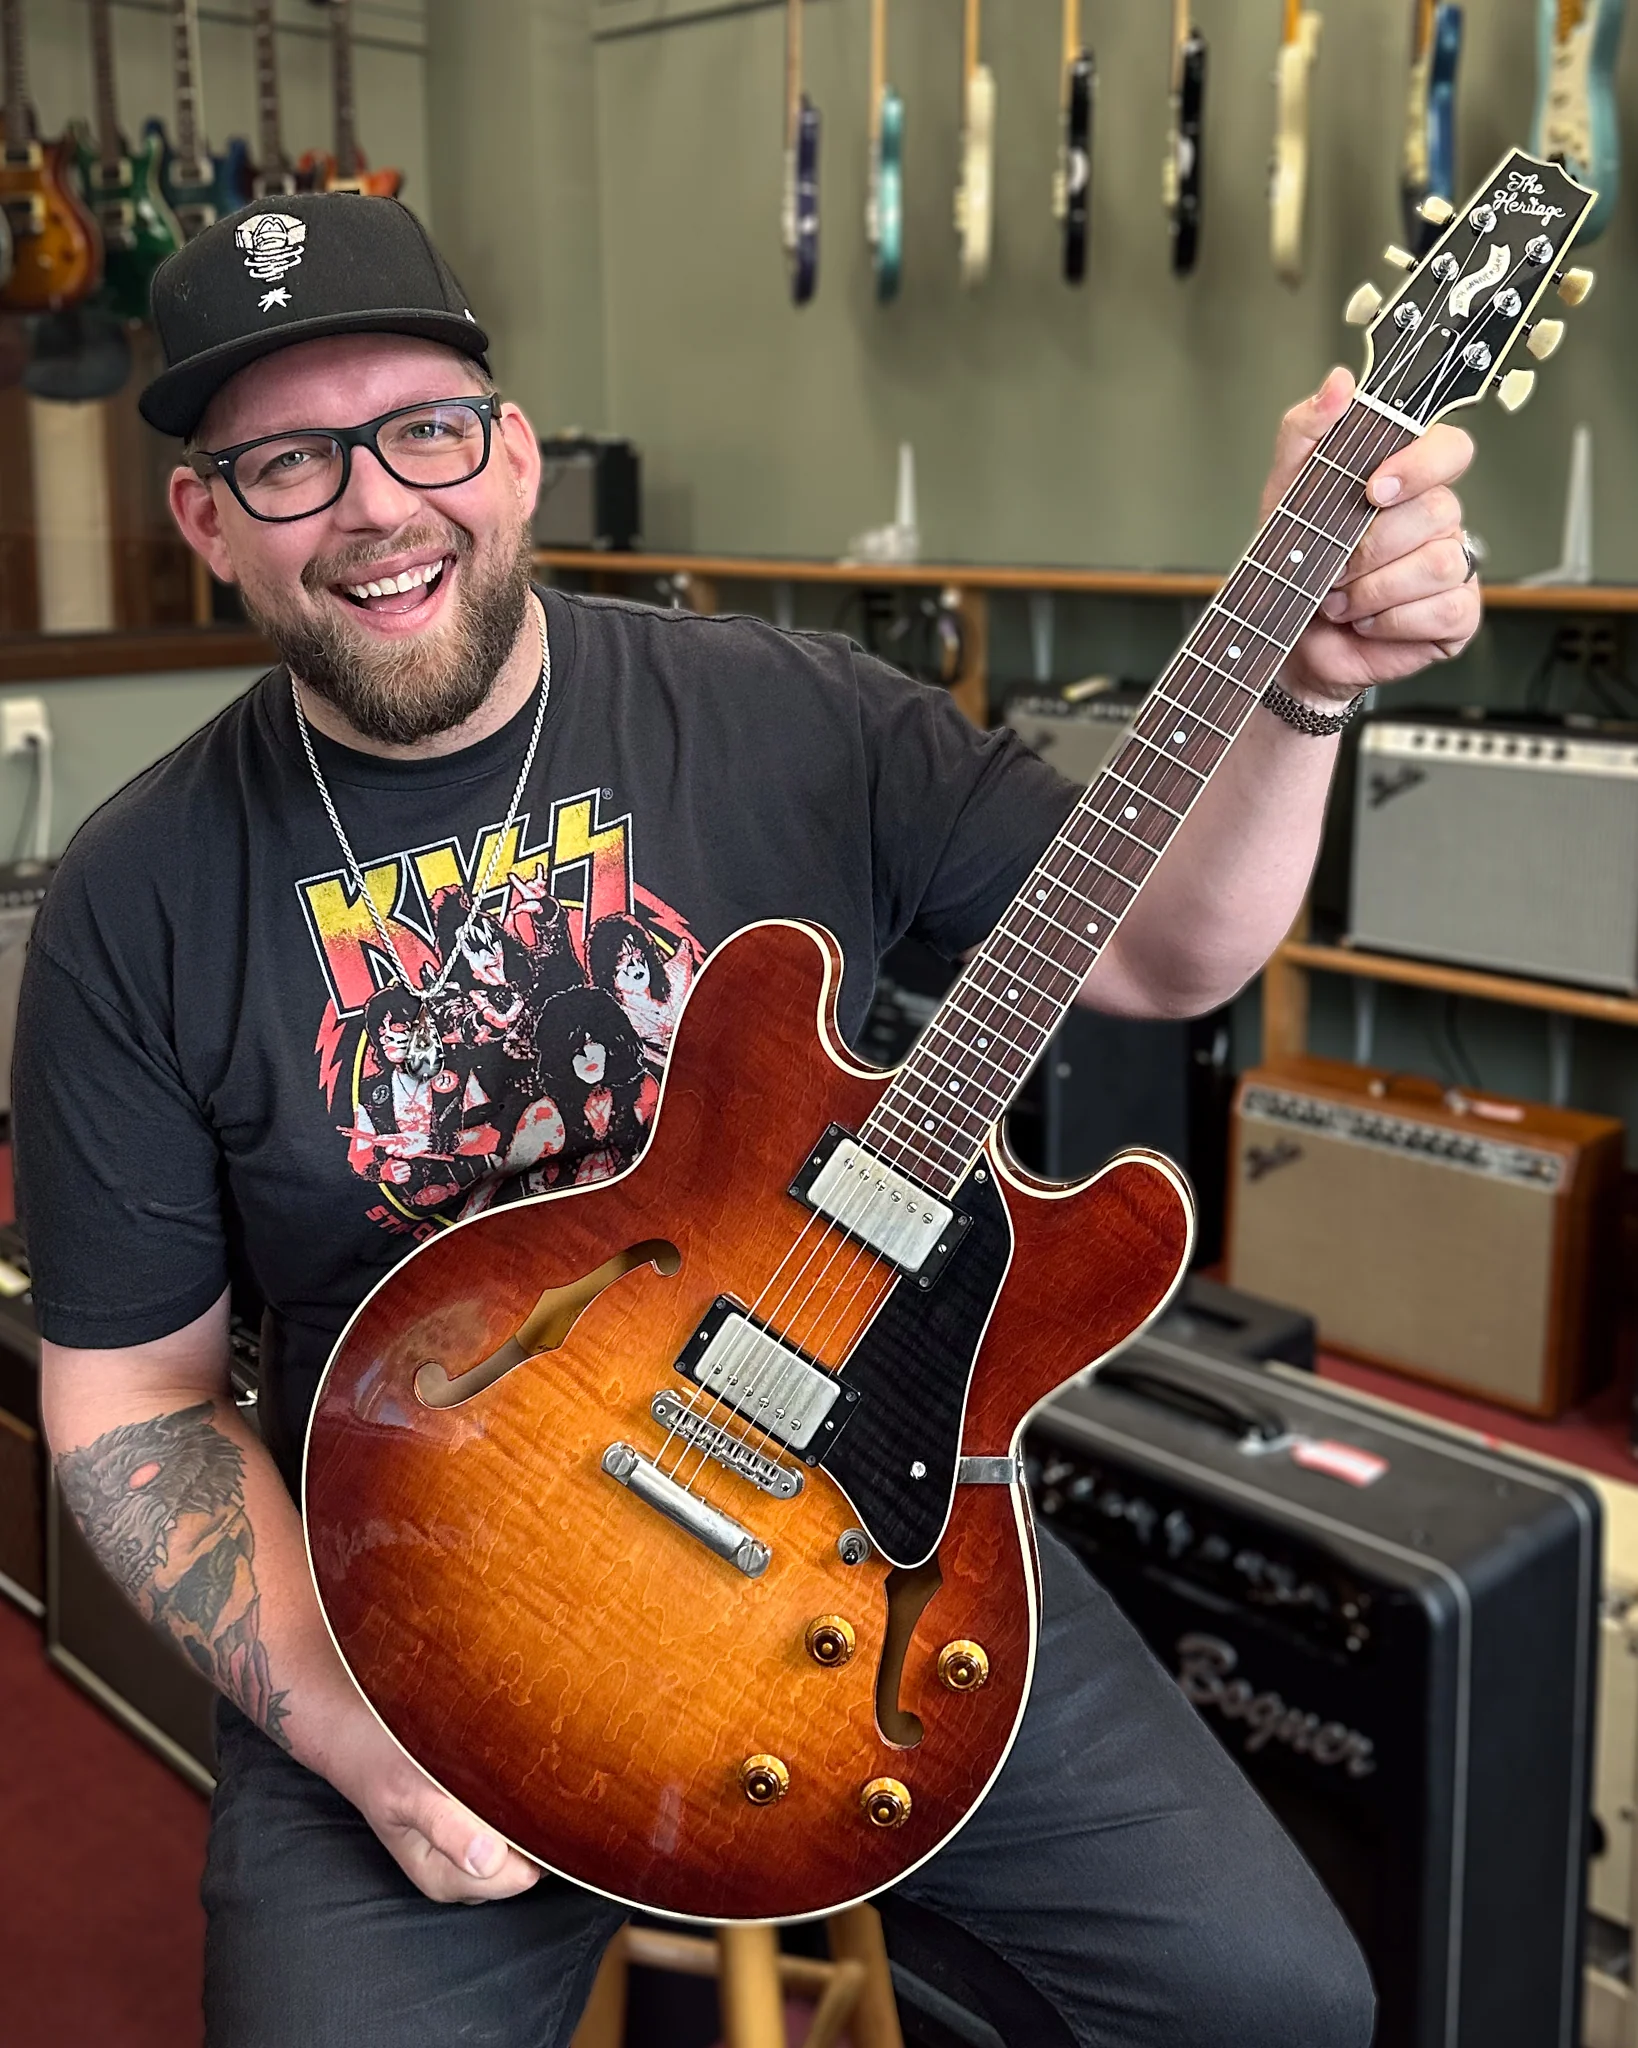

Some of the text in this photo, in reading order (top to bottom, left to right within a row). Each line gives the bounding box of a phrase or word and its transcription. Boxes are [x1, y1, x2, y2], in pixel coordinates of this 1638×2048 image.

[1507, 171, 1545, 194] The
[1493, 190, 1566, 226] Heritage
[1465, 253, 1504, 290] ANNIVERSARY
[295, 788, 635, 1020] KISS
